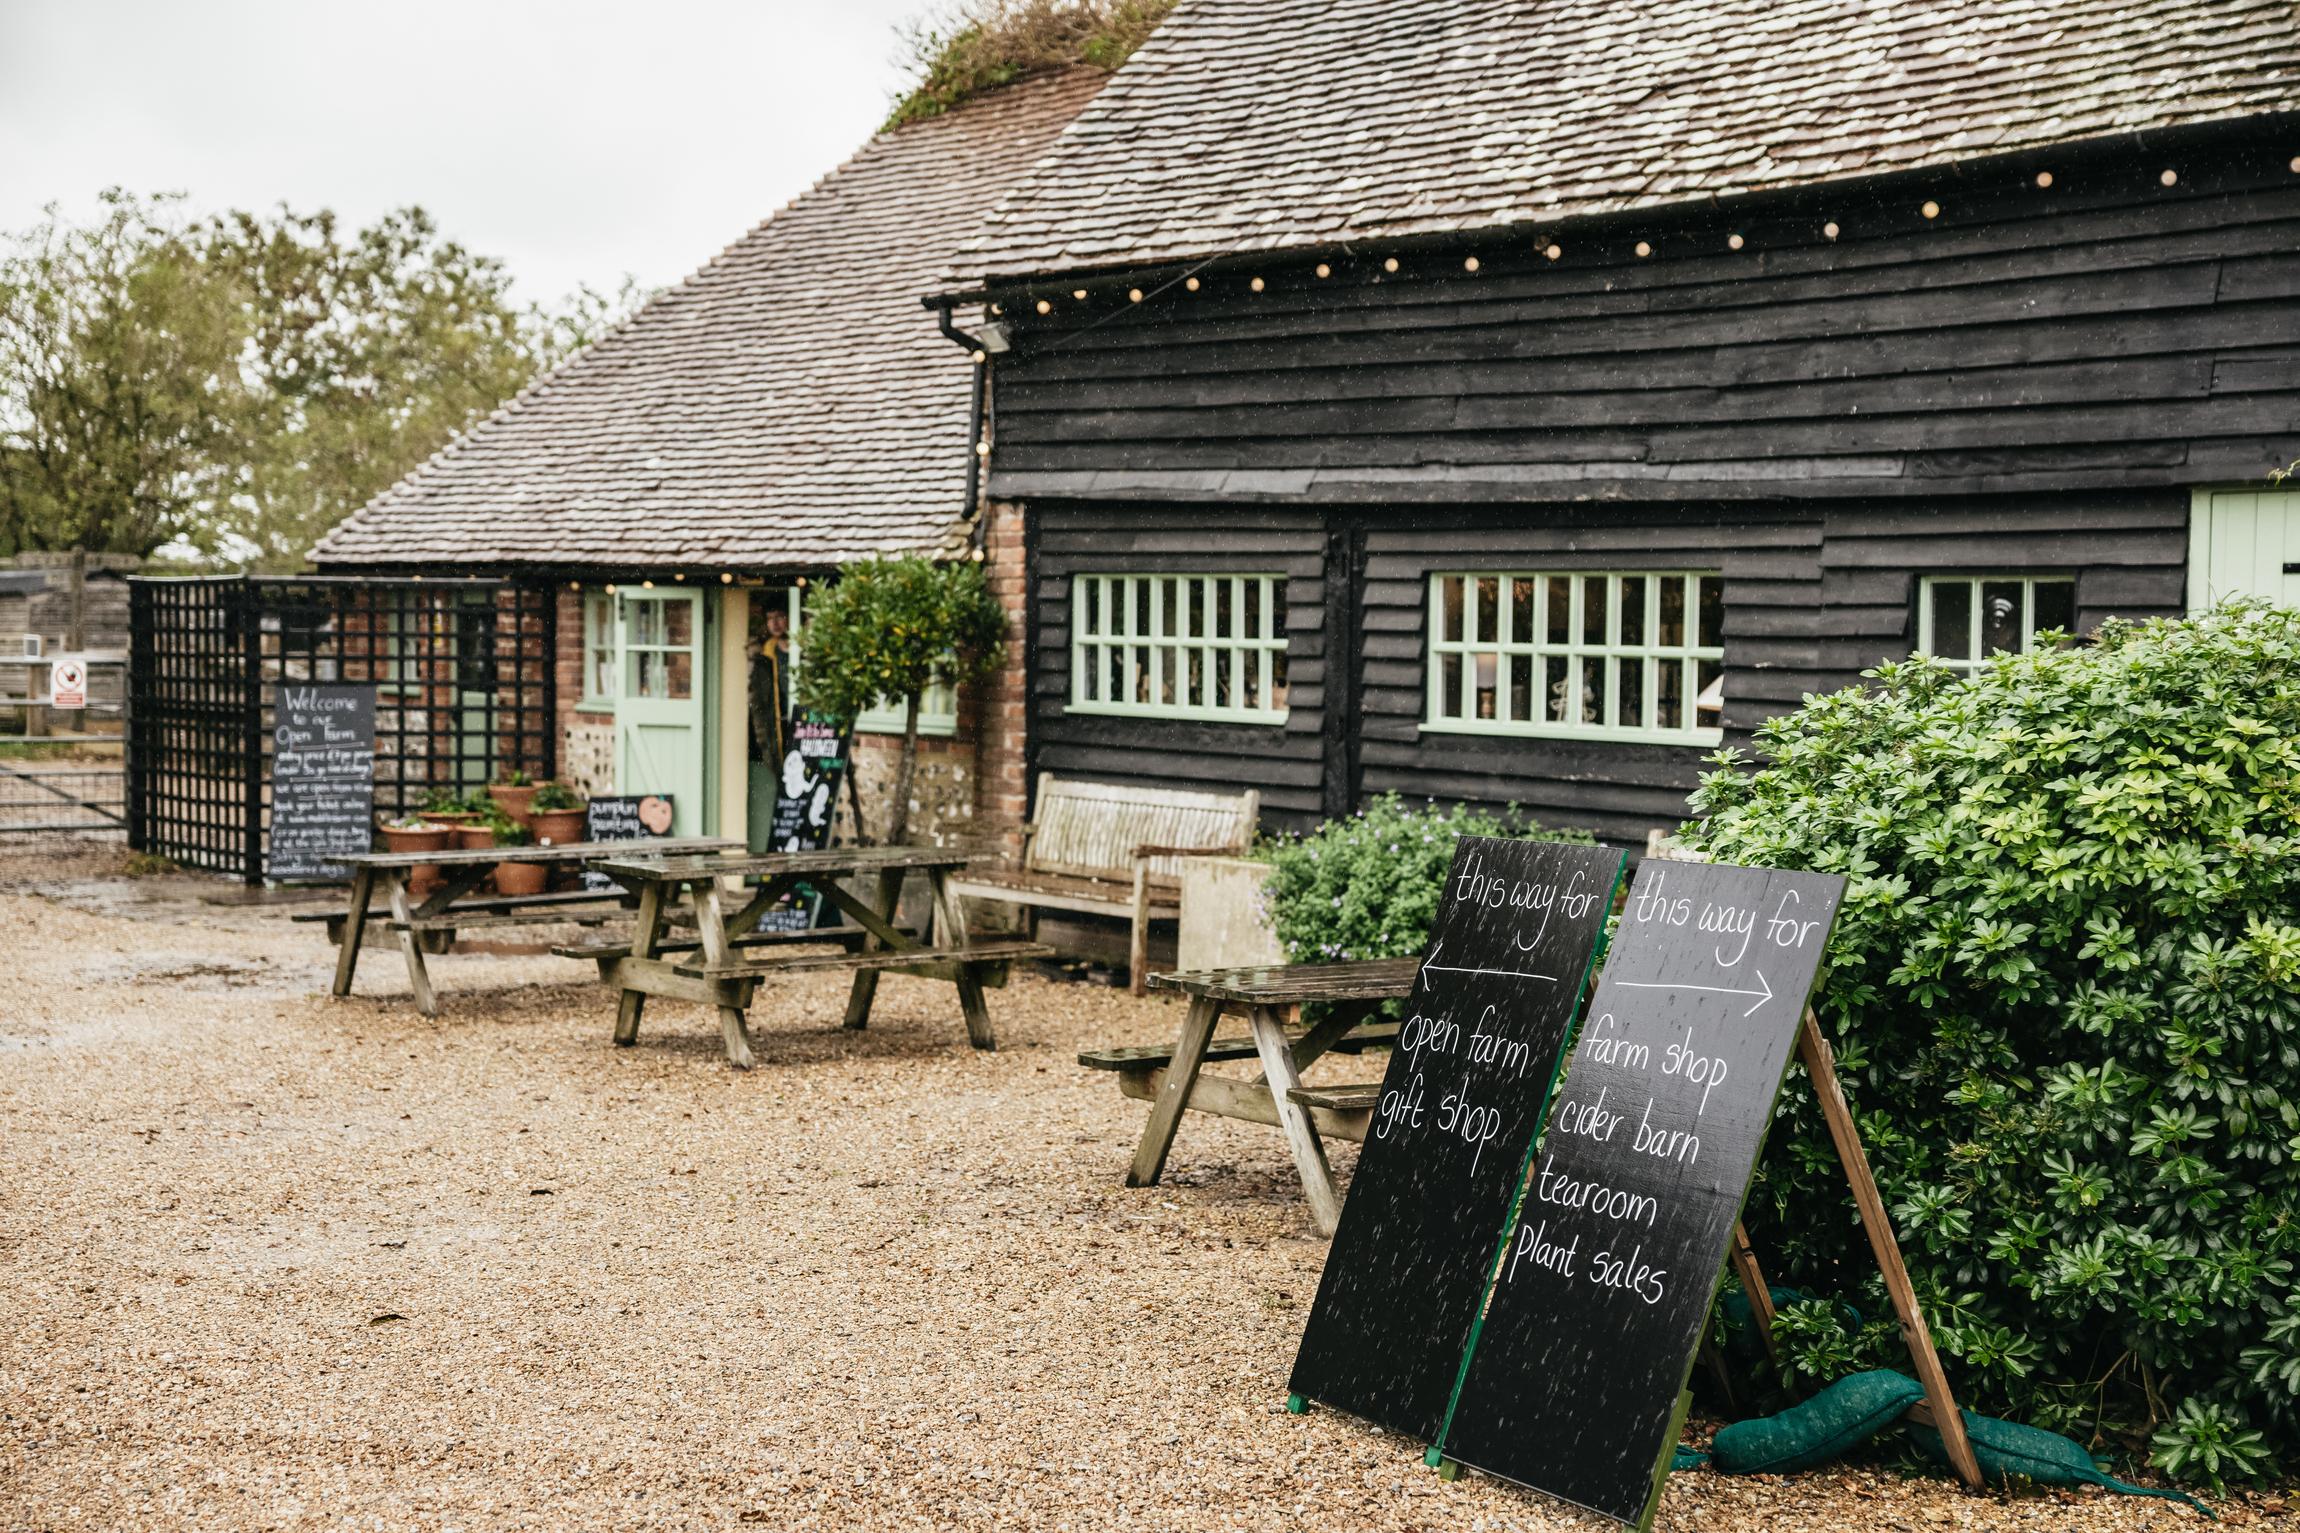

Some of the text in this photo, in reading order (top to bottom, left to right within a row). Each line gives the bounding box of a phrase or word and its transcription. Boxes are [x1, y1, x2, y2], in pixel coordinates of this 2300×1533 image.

[275, 723, 356, 751] Open Farm
[284, 687, 358, 711] Welcome
[292, 713, 333, 726] to our
[1457, 854, 1599, 951] this way for
[1637, 871, 1819, 967] this way for
[1402, 1005, 1529, 1078] open farm
[1585, 1014, 1727, 1115] farm shop
[1376, 1074, 1500, 1177] gift shop
[1560, 1086, 1700, 1164] cider barn
[1539, 1155, 1657, 1226] tearoom
[1509, 1223, 1666, 1304] plant sales
